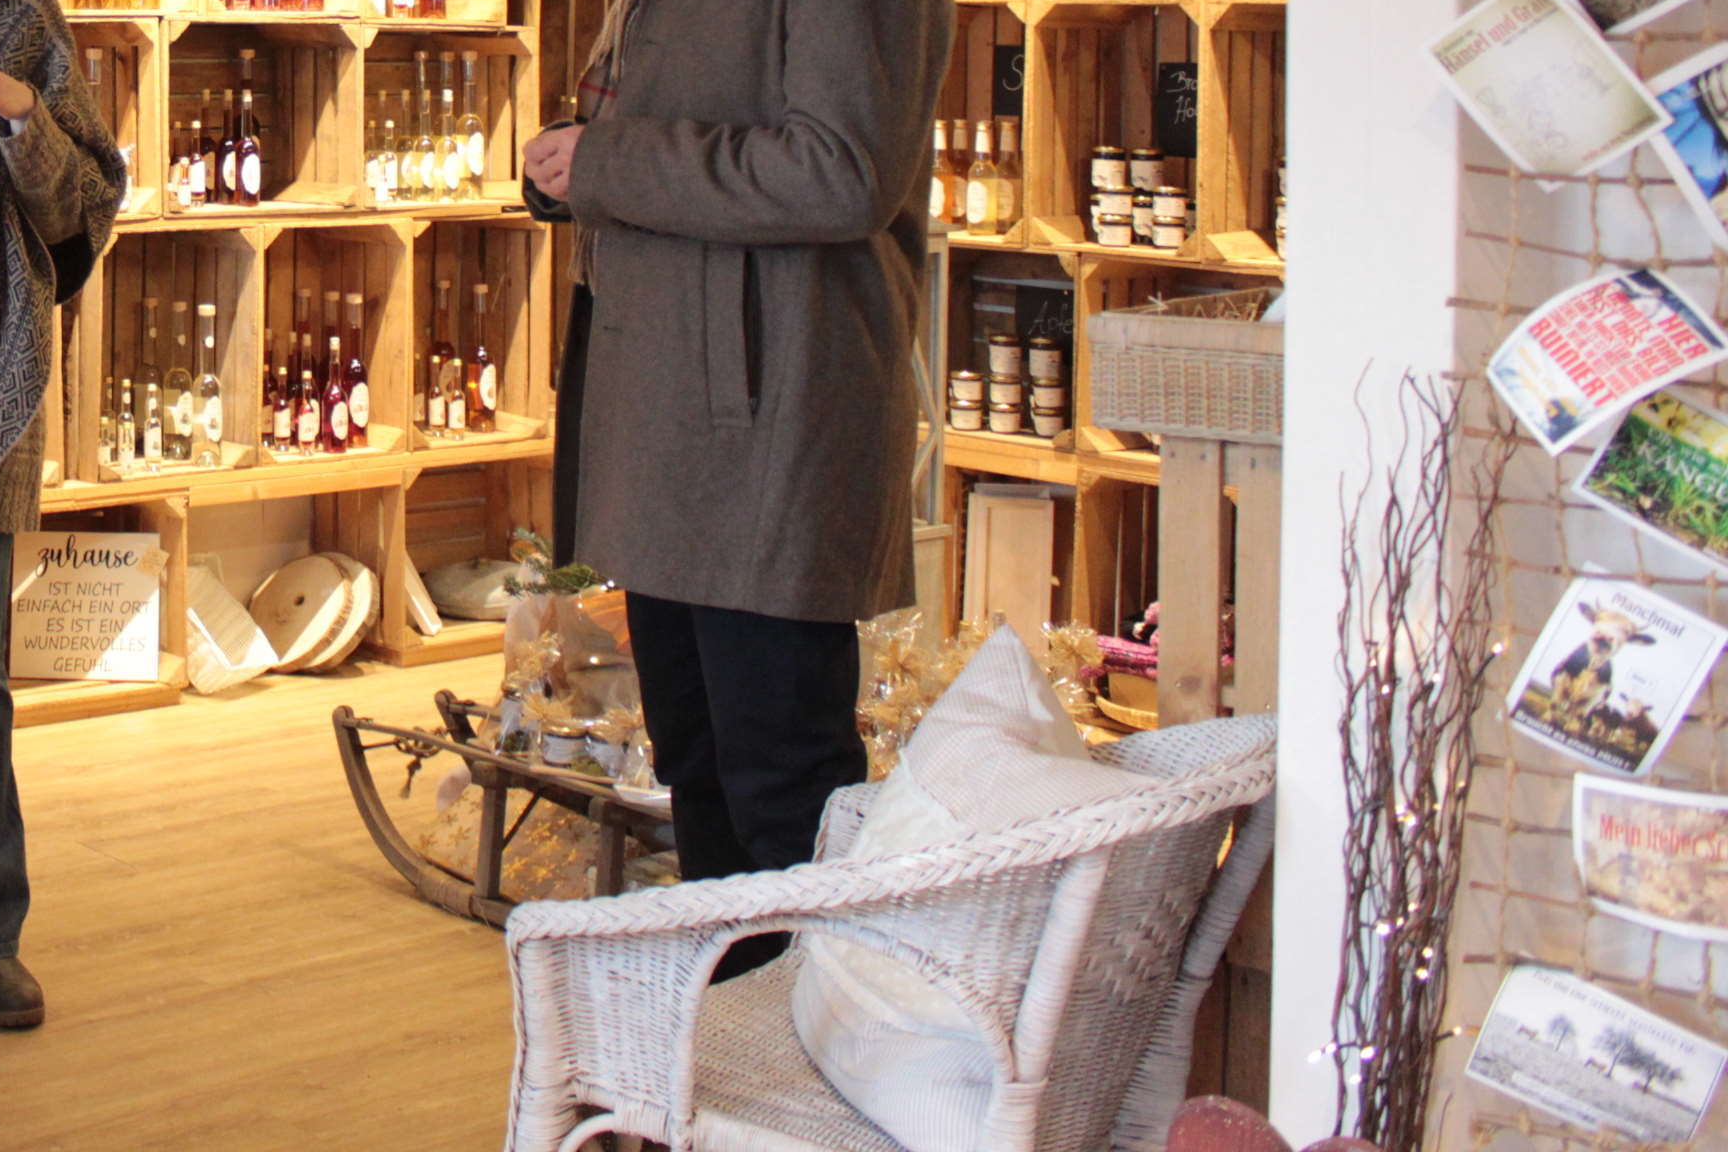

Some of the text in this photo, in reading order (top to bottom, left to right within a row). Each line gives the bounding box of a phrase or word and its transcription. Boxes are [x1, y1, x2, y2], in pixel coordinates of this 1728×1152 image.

[1527, 317, 1618, 409] RUINIERT
[35, 534, 138, 577] zuhause
[48, 581, 124, 596] IST NICHT
[16, 599, 151, 615] EINFACH EIN ORT
[46, 617, 125, 633] ES IST EIN
